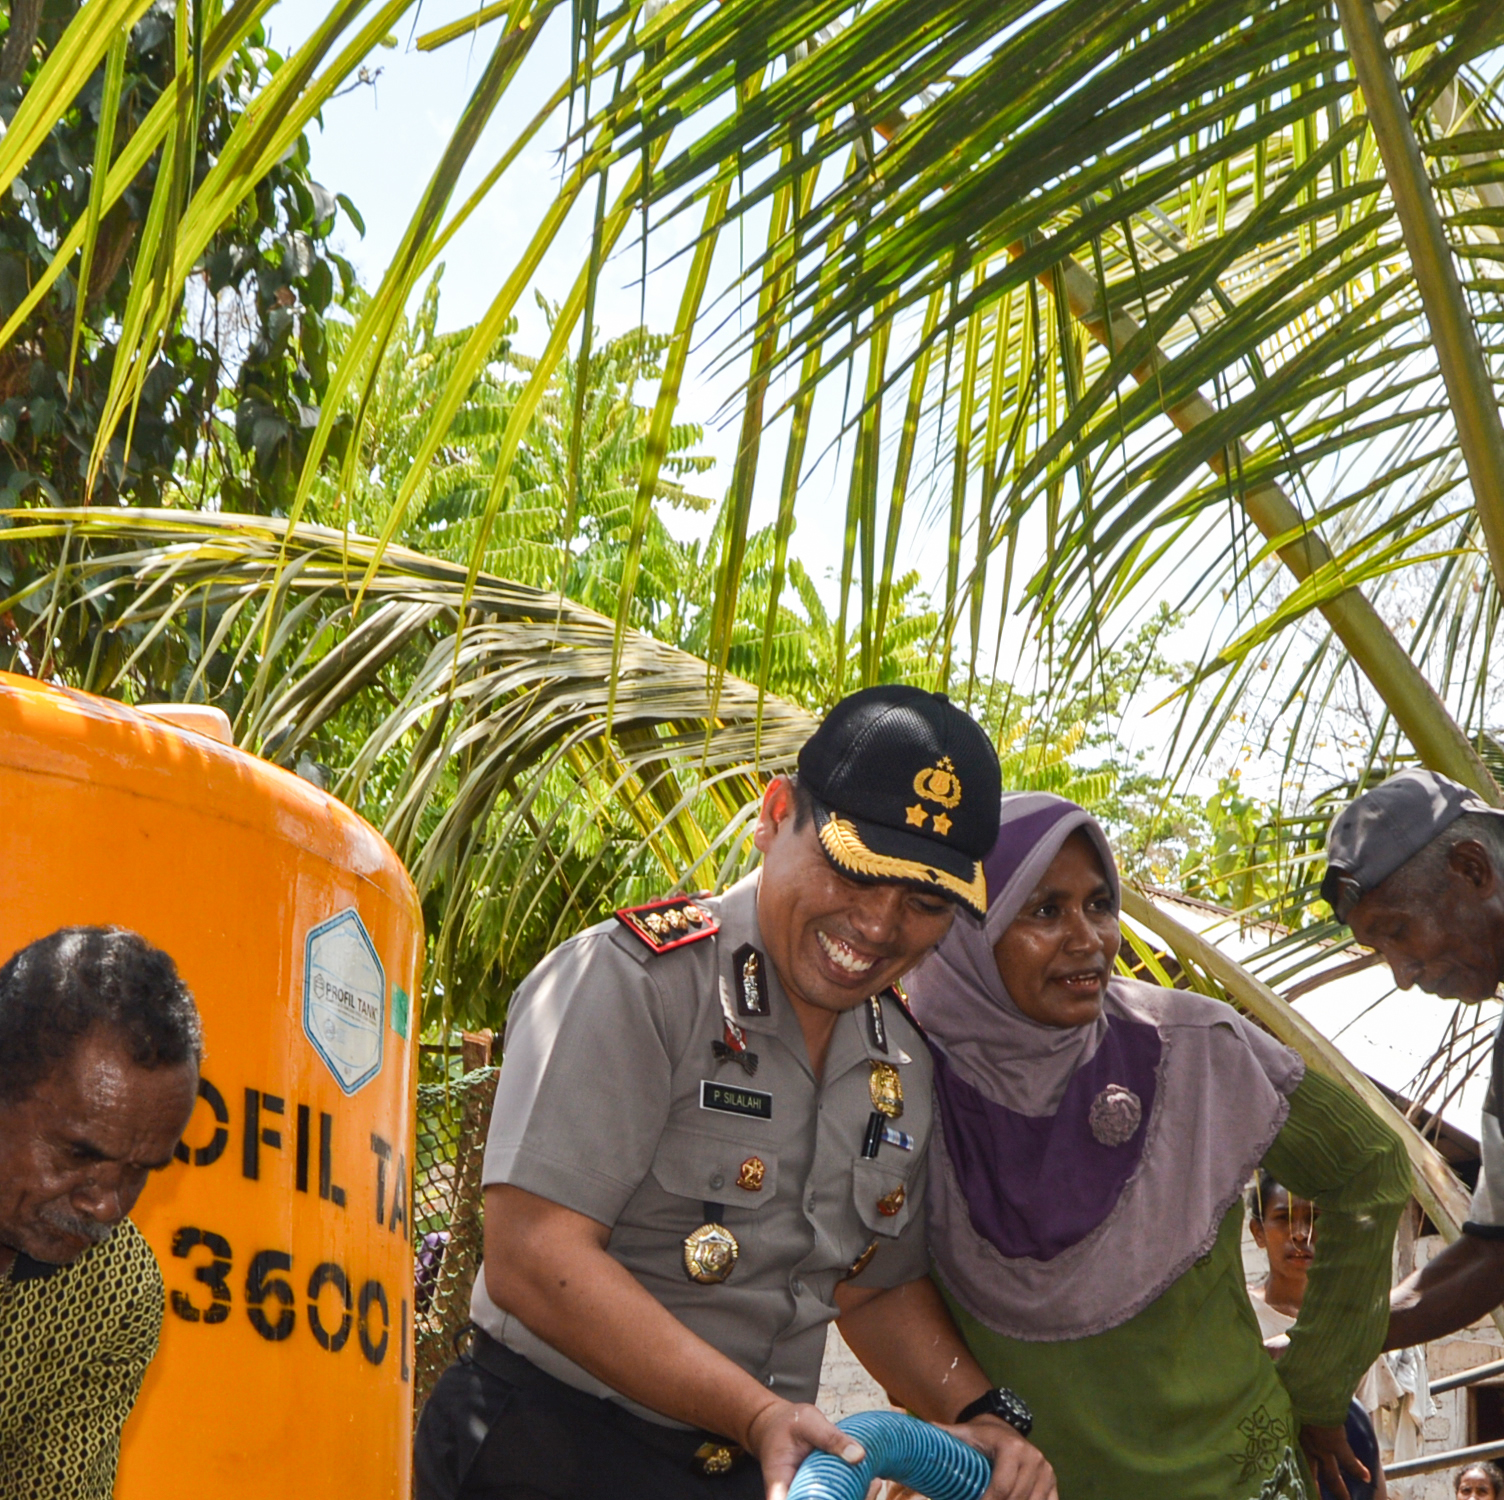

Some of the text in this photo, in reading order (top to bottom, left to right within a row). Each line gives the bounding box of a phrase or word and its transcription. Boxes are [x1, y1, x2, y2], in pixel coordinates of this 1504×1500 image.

[326, 982, 356, 1009] PROFIL
[357, 997, 378, 1021] TANK
[723, 1092, 762, 1110] SILALAHI
[370, 1132, 414, 1246] TA
[171, 1226, 389, 1366] 3600
